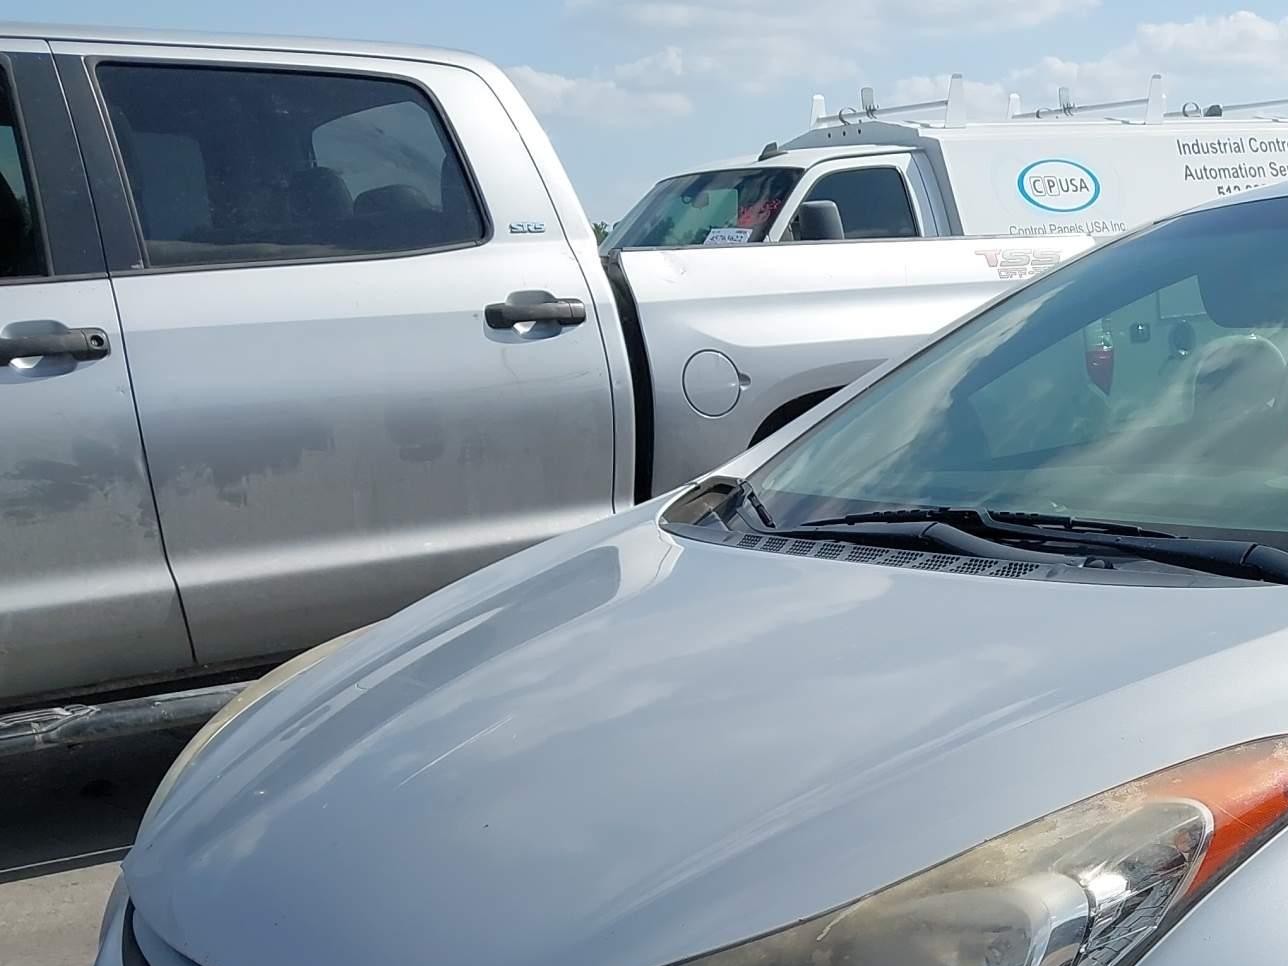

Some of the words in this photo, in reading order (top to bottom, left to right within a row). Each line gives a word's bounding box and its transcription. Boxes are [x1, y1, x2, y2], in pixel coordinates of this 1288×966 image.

[1176, 137, 1246, 156] Industrial
[1184, 162, 1266, 181] Automation
[1009, 223, 1046, 235] Control
[1049, 223, 1083, 234] Panels
[1085, 221, 1109, 234] USA
